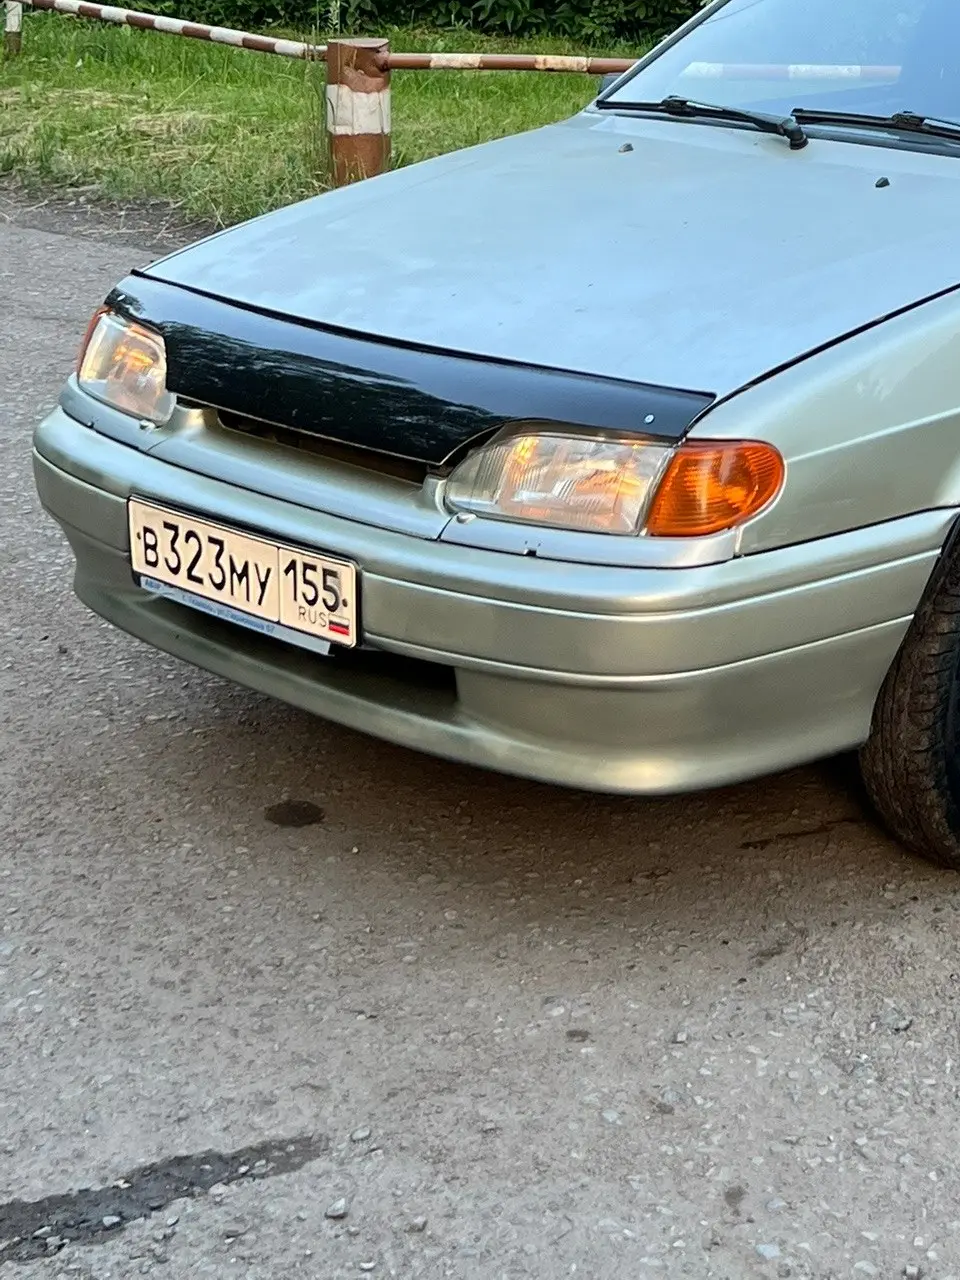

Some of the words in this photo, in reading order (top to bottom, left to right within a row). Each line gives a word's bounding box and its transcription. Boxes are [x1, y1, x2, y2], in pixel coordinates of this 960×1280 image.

[143, 521, 271, 606] В323МУ
[284, 558, 339, 612] 155
[298, 605, 328, 628] RUS
